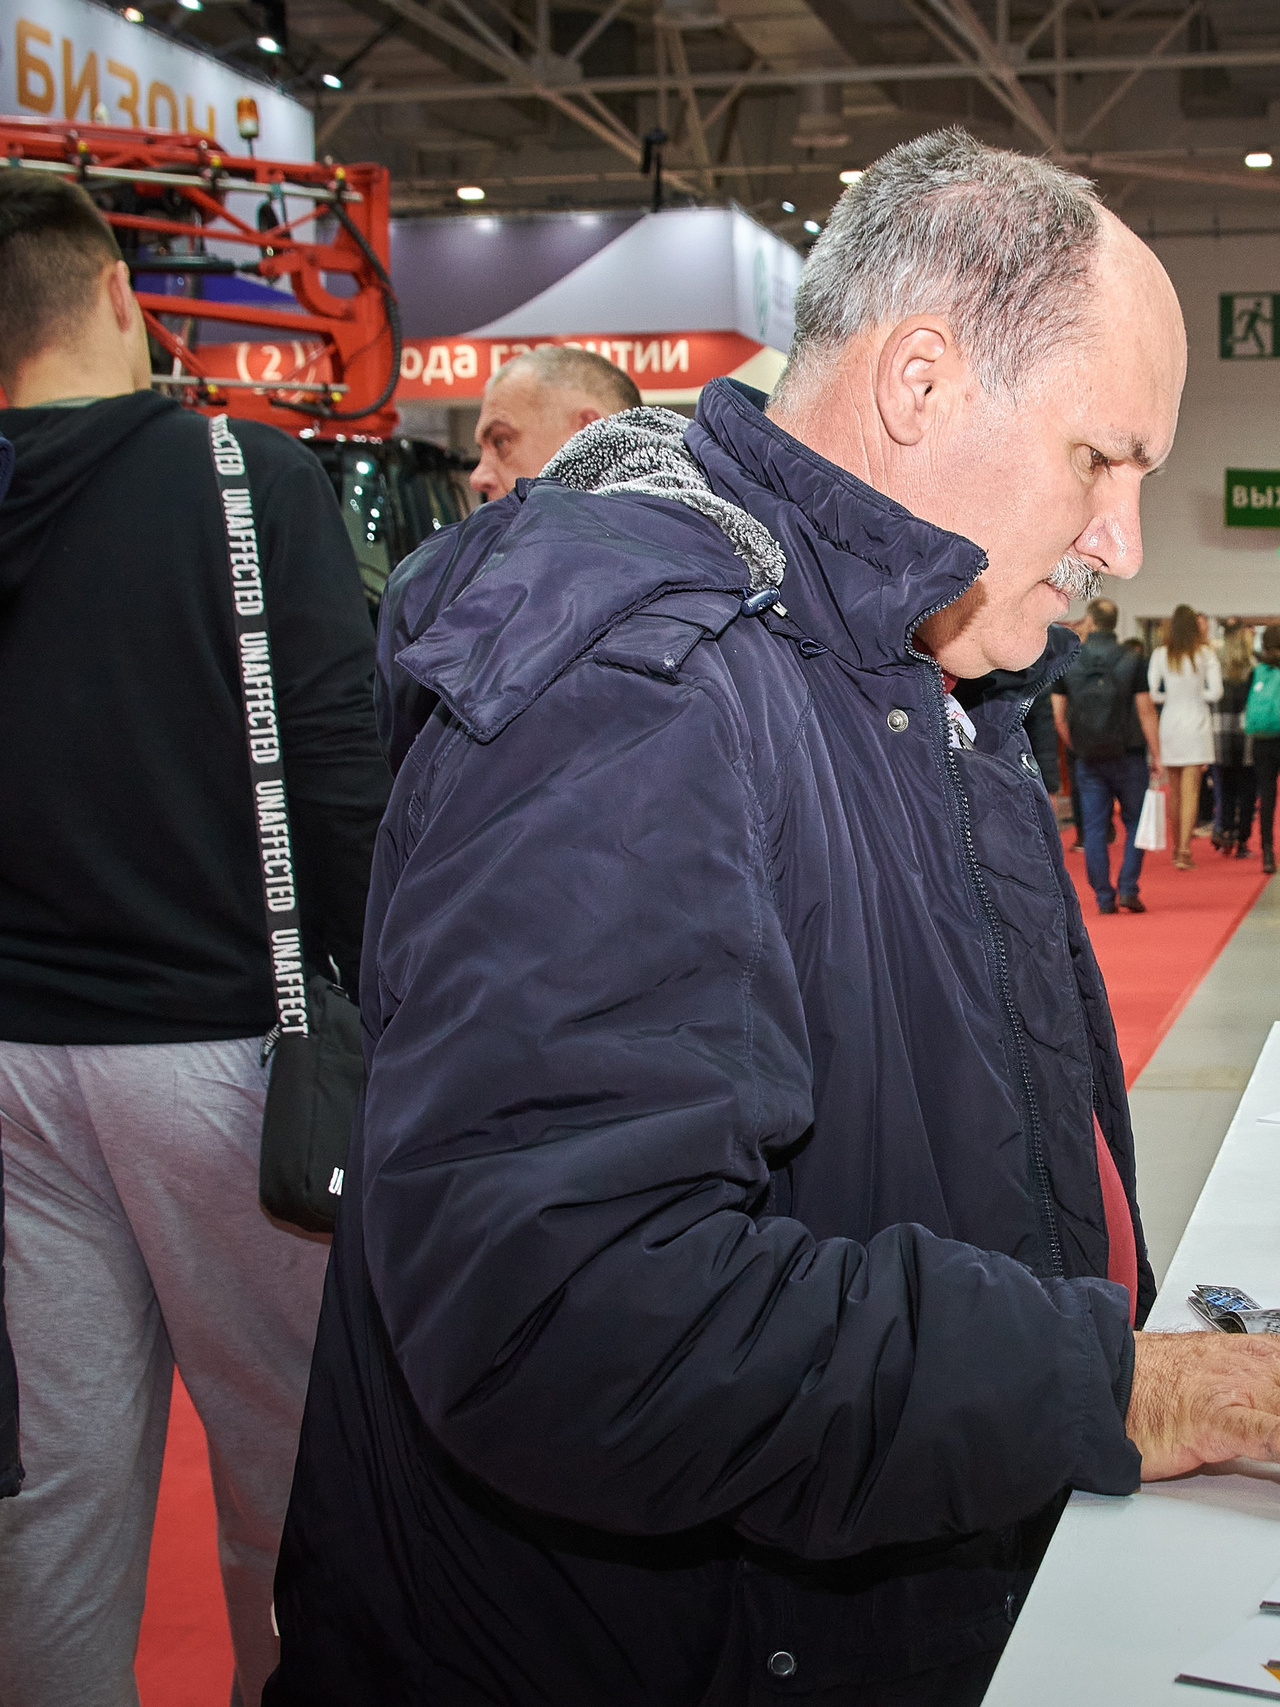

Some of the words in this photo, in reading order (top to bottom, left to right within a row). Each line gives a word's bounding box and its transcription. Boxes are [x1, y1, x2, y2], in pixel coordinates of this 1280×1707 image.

[15, 17, 215, 141] БИЗОН
[400, 344, 478, 386] ода
[490, 339, 689, 377] гтии
[221, 487, 264, 616] UNAFFECTED
[239, 630, 281, 765] UNAFFECTED
[255, 779, 296, 913] UNAFFECTED
[271, 928, 309, 1038] UNAFFECT
